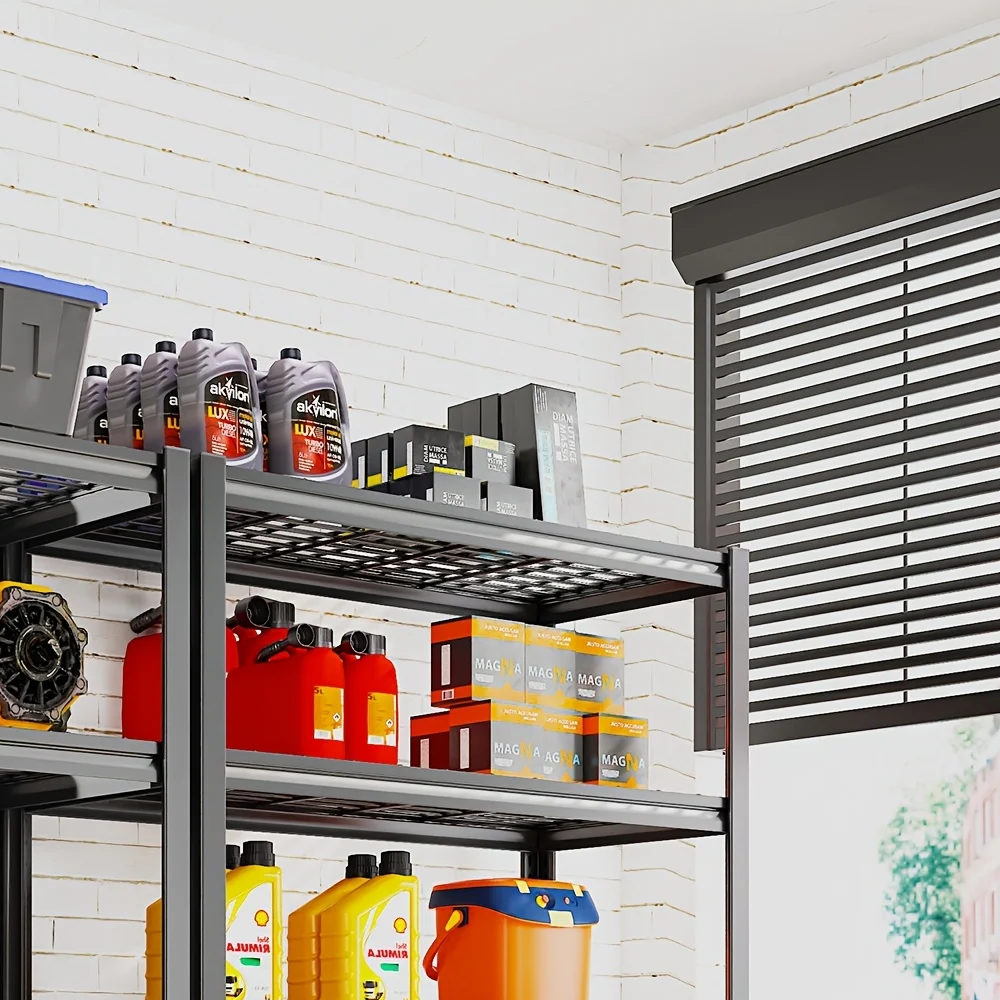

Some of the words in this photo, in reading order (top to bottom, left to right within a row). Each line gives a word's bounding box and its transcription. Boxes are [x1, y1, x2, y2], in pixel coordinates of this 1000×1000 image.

[208, 406, 229, 420] LUX
[552, 411, 574, 423] DIAM
[295, 424, 316, 437] LUX
[429, 445, 448, 454] UTRICE
[560, 423, 569, 462] MASSA
[567, 422, 577, 464] UTRICE
[429, 452, 448, 460] MASSA
[475, 657, 522, 678] MAGNA
[528, 665, 573, 684] MAGNA
[578, 673, 621, 691] MAGNA
[494, 741, 541, 759] MAGNA
[545, 748, 580, 768] AGNA
[602, 753, 645, 772] MAGNA
